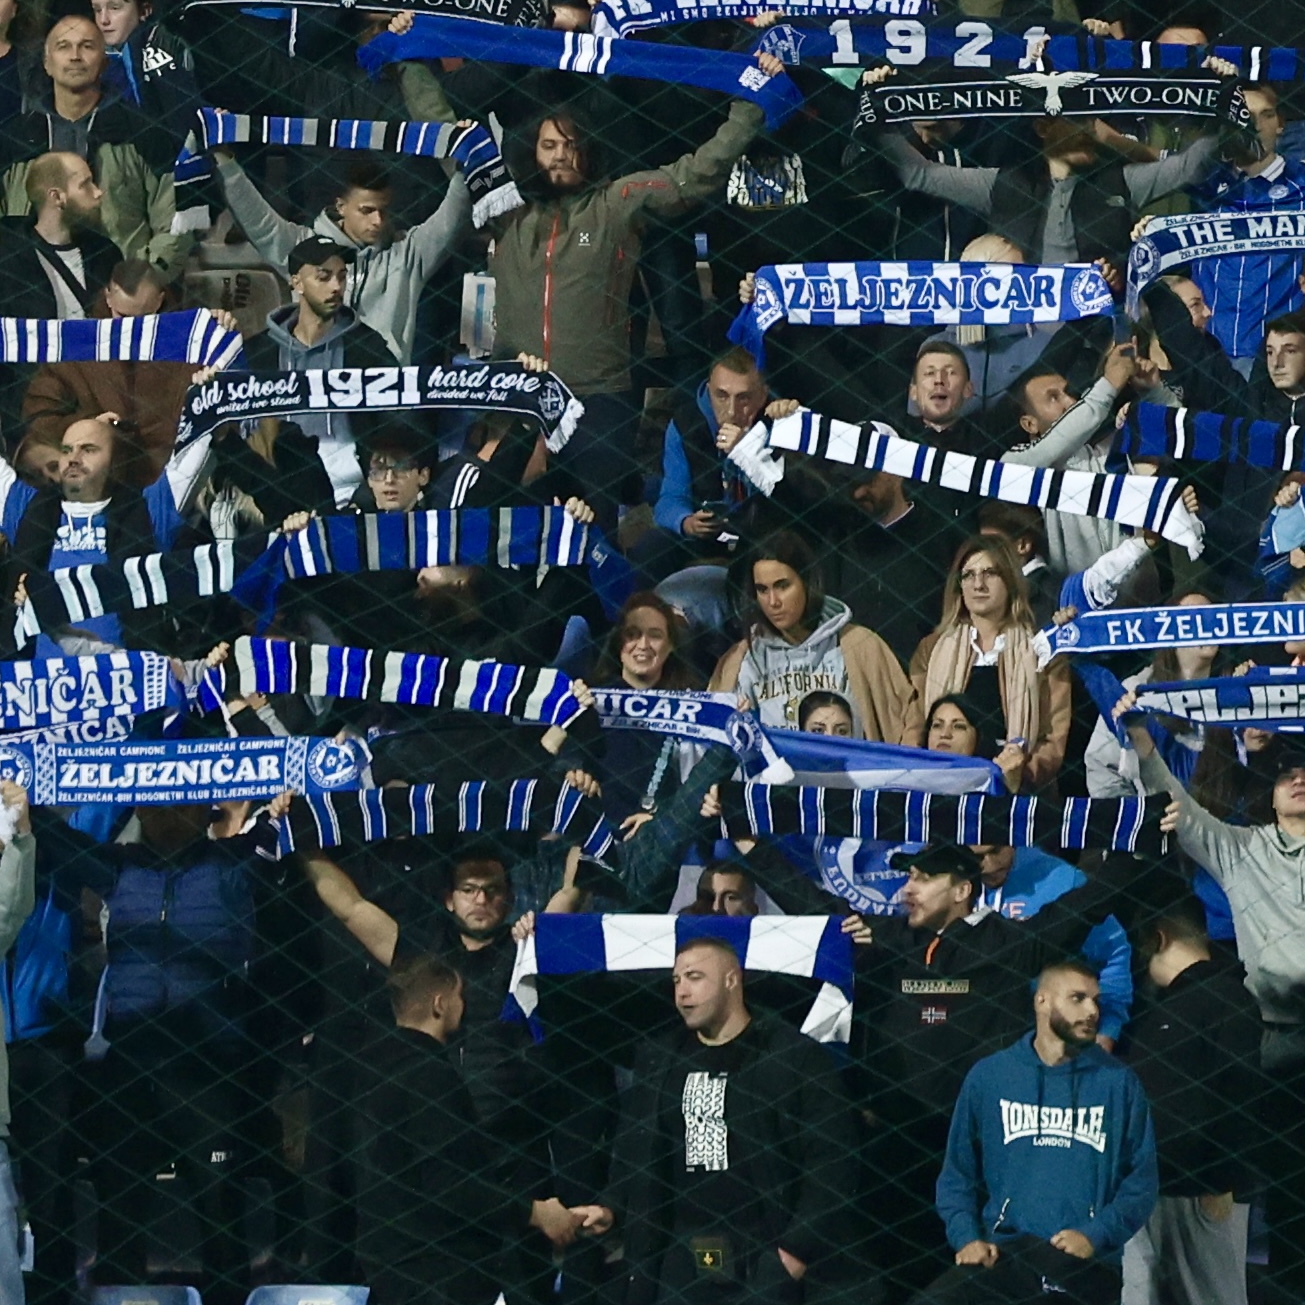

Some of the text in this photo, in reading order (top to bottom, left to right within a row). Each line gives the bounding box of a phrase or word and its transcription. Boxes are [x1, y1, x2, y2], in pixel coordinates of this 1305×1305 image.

[884, 87, 1024, 115] ONE-NINE
[1082, 85, 1221, 109] TWO-ONE
[1169, 220, 1236, 247] THE
[784, 268, 1057, 312] ŽELJEZNIČAR
[191, 371, 300, 416] old school
[305, 365, 421, 408] 1921
[427, 364, 542, 395] hard core
[216, 394, 303, 416] united stand
[427, 388, 469, 401] divided
[1107, 618, 1146, 645] FK
[120, 743, 166, 755] CAMPIONE
[239, 738, 285, 751] CAMPIONE
[59, 753, 281, 789] ŽELJEZNIČAR
[1033, 1136, 1072, 1149] LONDON
